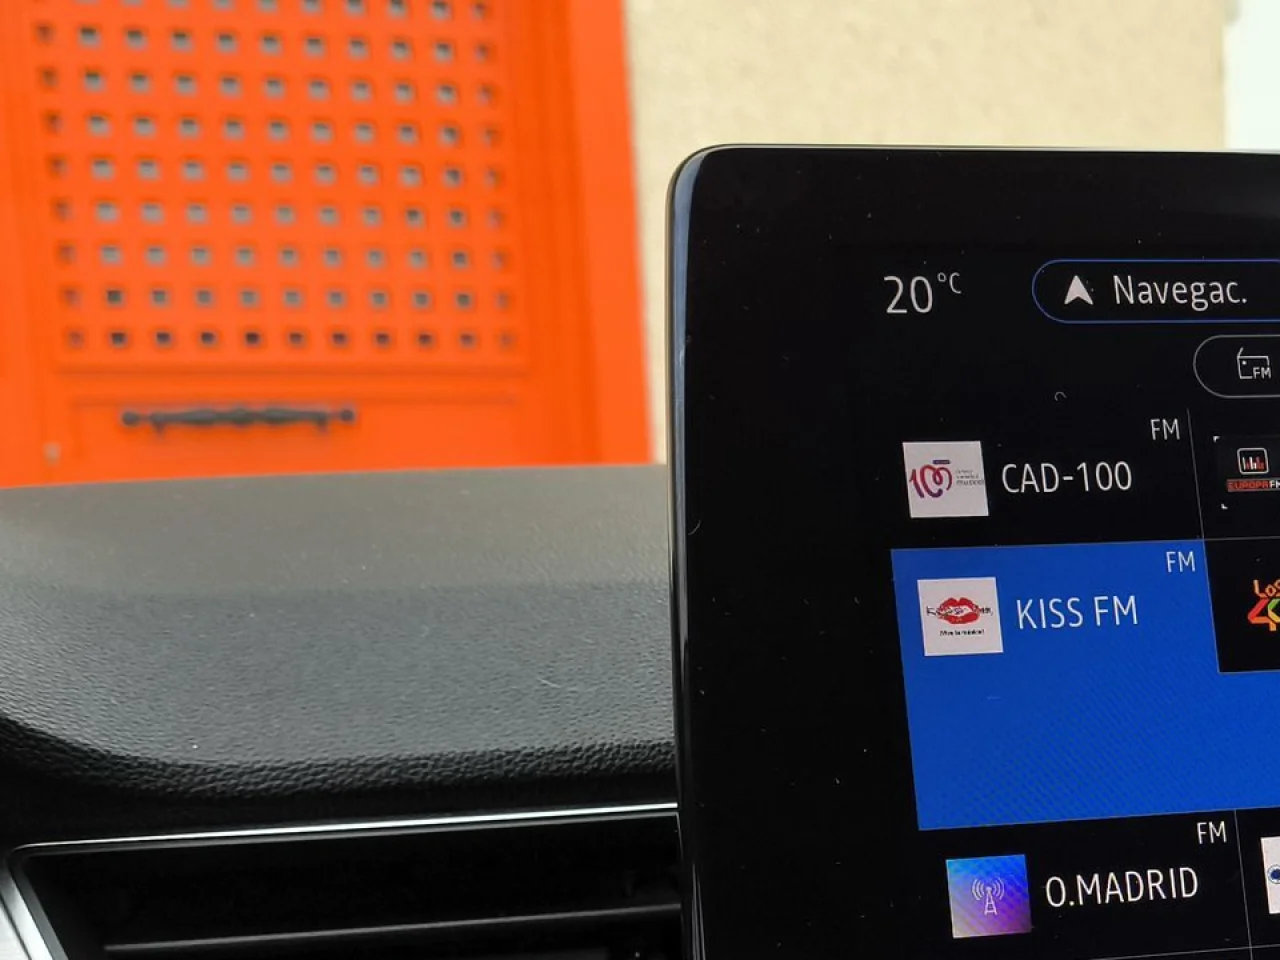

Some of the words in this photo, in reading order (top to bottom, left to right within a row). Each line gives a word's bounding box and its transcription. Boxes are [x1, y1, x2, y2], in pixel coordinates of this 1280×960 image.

[1113, 275, 1247, 312] Navegac.
[1252, 366, 1272, 379] FM
[1150, 418, 1180, 440] FM
[1002, 461, 1132, 493] CAD-100
[1166, 550, 1196, 573] FM
[1016, 600, 1082, 630] KISS
[1093, 595, 1138, 626] FM
[1196, 820, 1227, 845] FM
[1045, 867, 1198, 908] O.MADRID
